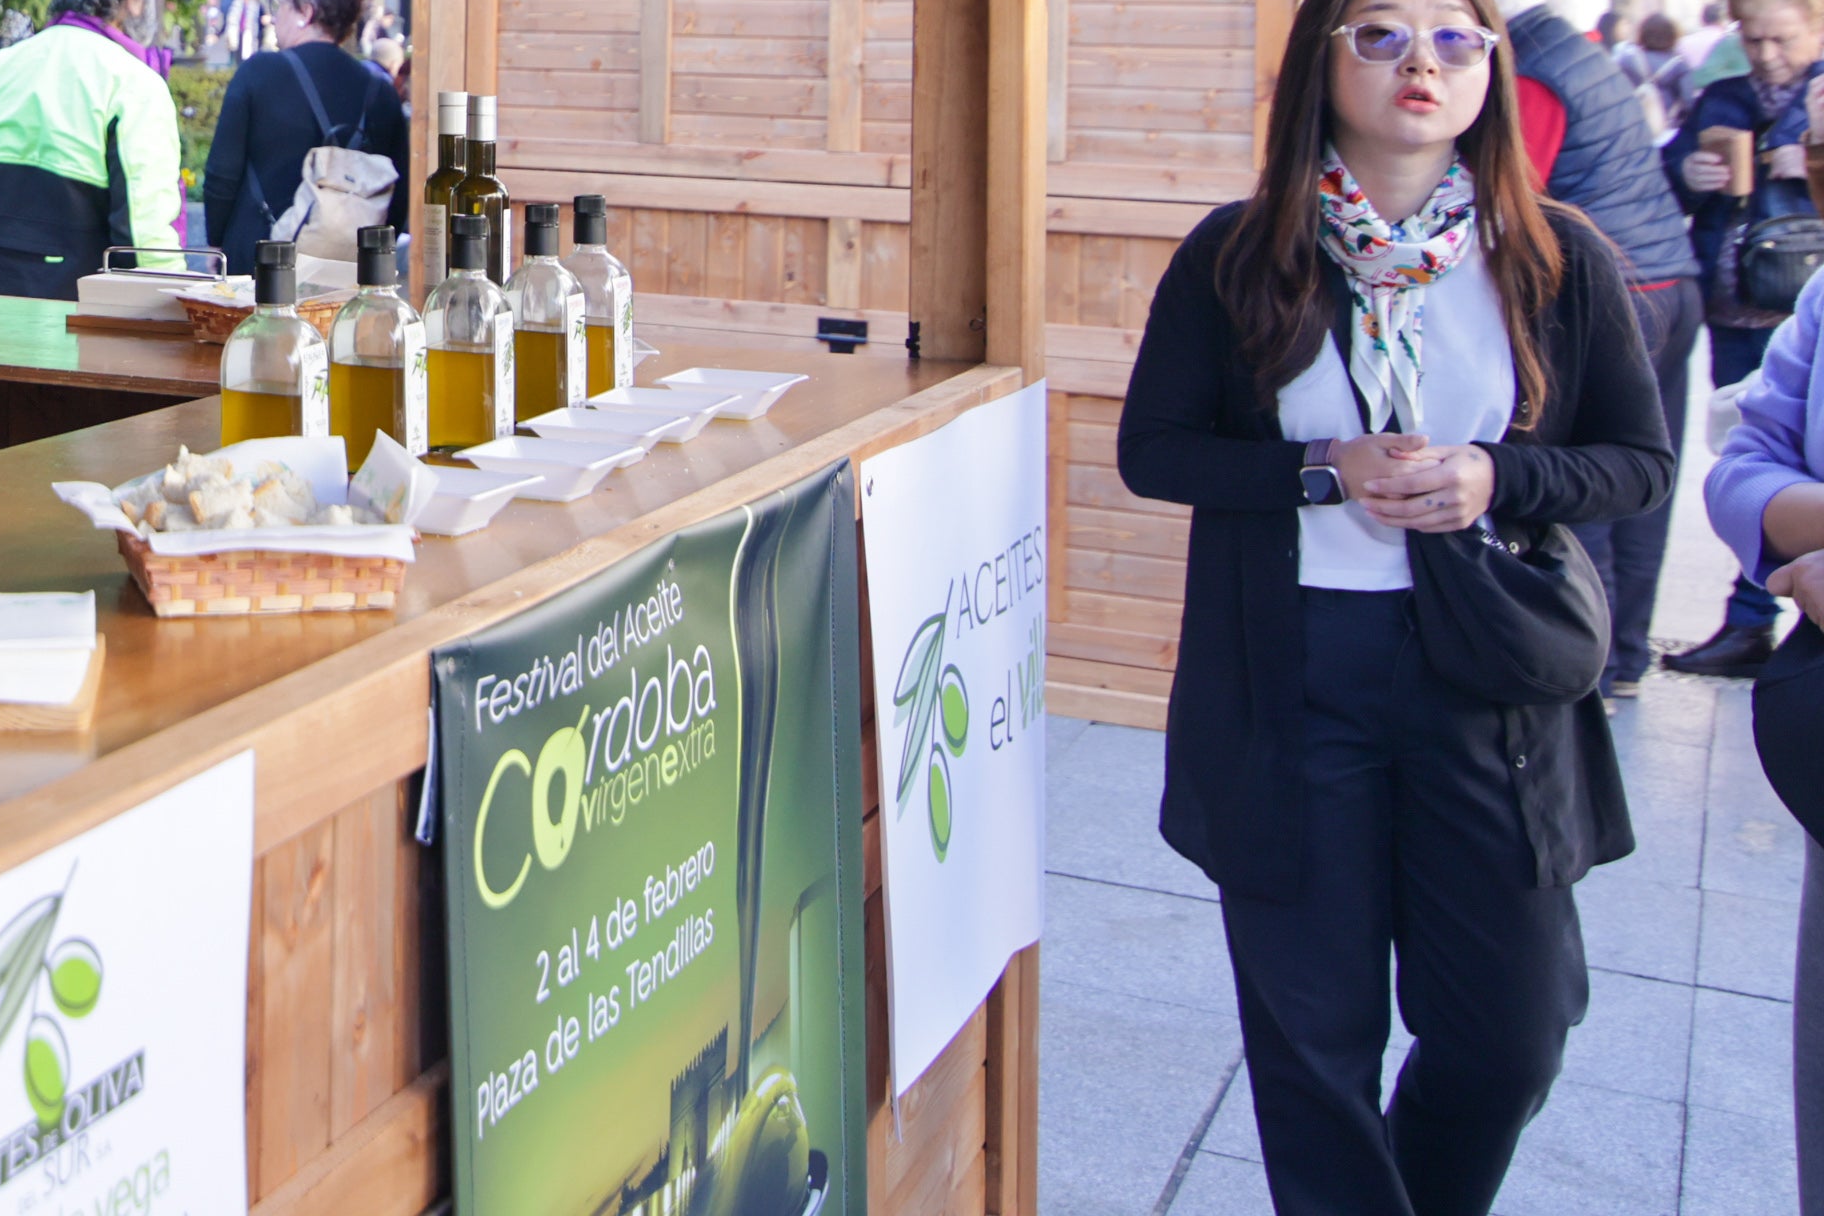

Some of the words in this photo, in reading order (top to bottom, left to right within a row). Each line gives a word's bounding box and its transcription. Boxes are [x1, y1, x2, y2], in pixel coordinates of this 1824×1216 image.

[956, 525, 1044, 639] ACEITES
[475, 633, 584, 733] Festival
[587, 610, 621, 680] del
[623, 579, 684, 655] Aceite
[990, 669, 1013, 751] el
[581, 718, 717, 832] virgenextra
[535, 949, 551, 1004] 2
[557, 927, 581, 988] al
[585, 914, 601, 963] 4
[606, 896, 638, 951] de
[643, 840, 715, 925] febrero
[477, 1048, 540, 1141] Plaza
[545, 1014, 581, 1075] de
[588, 985, 621, 1043] las
[625, 907, 715, 1009] Tendillas
[63, 1055, 145, 1141] OLIVA
[43, 1131, 92, 1198] SUR
